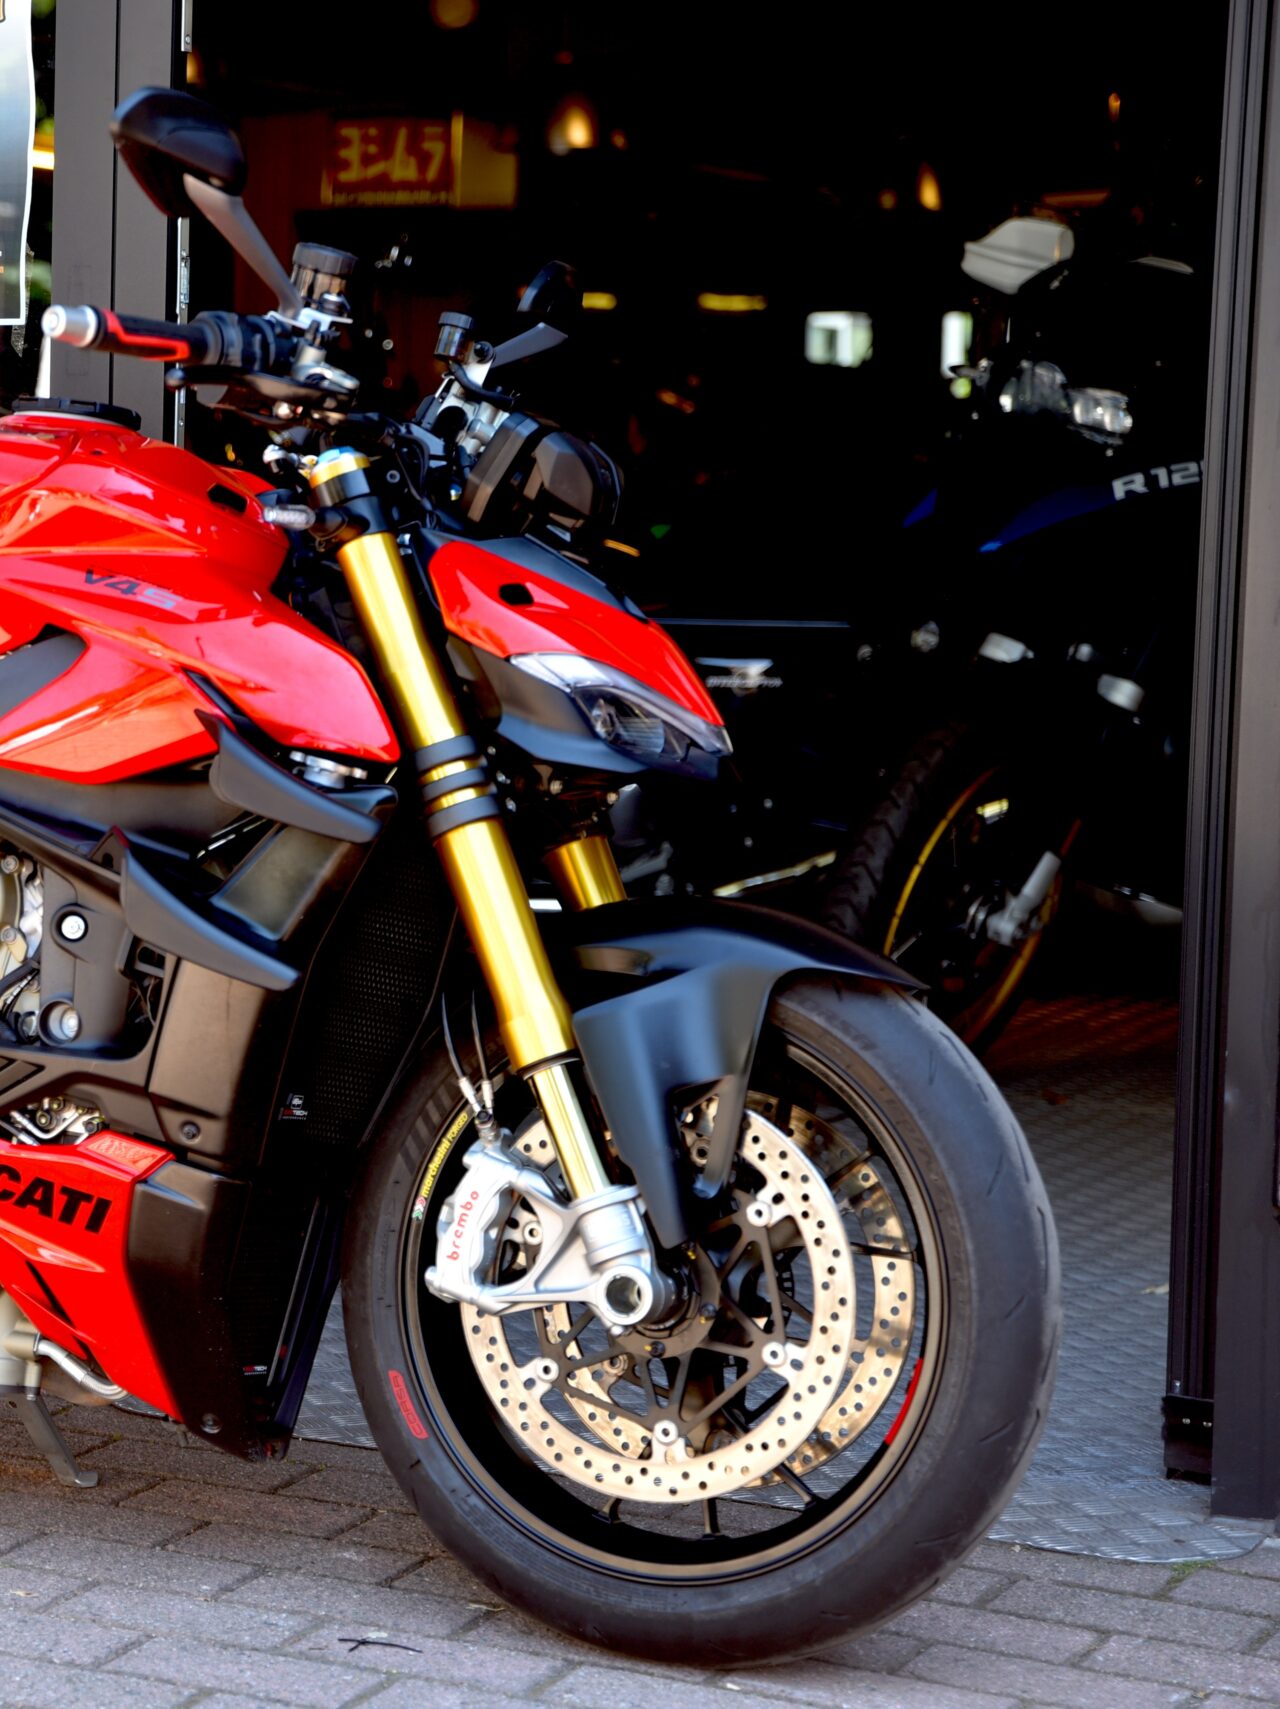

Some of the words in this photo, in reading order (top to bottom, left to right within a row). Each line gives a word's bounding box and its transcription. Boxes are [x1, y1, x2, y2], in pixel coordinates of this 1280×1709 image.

[337, 126, 446, 182] ヨシムラ
[1112, 472, 1149, 501] R
[1150, 460, 1203, 489] 12
[421, 1138, 451, 1198] marchesini
[447, 1112, 468, 1141] FORGED
[446, 1190, 480, 1261] brembo
[392, 1374, 424, 1436] CORSA
